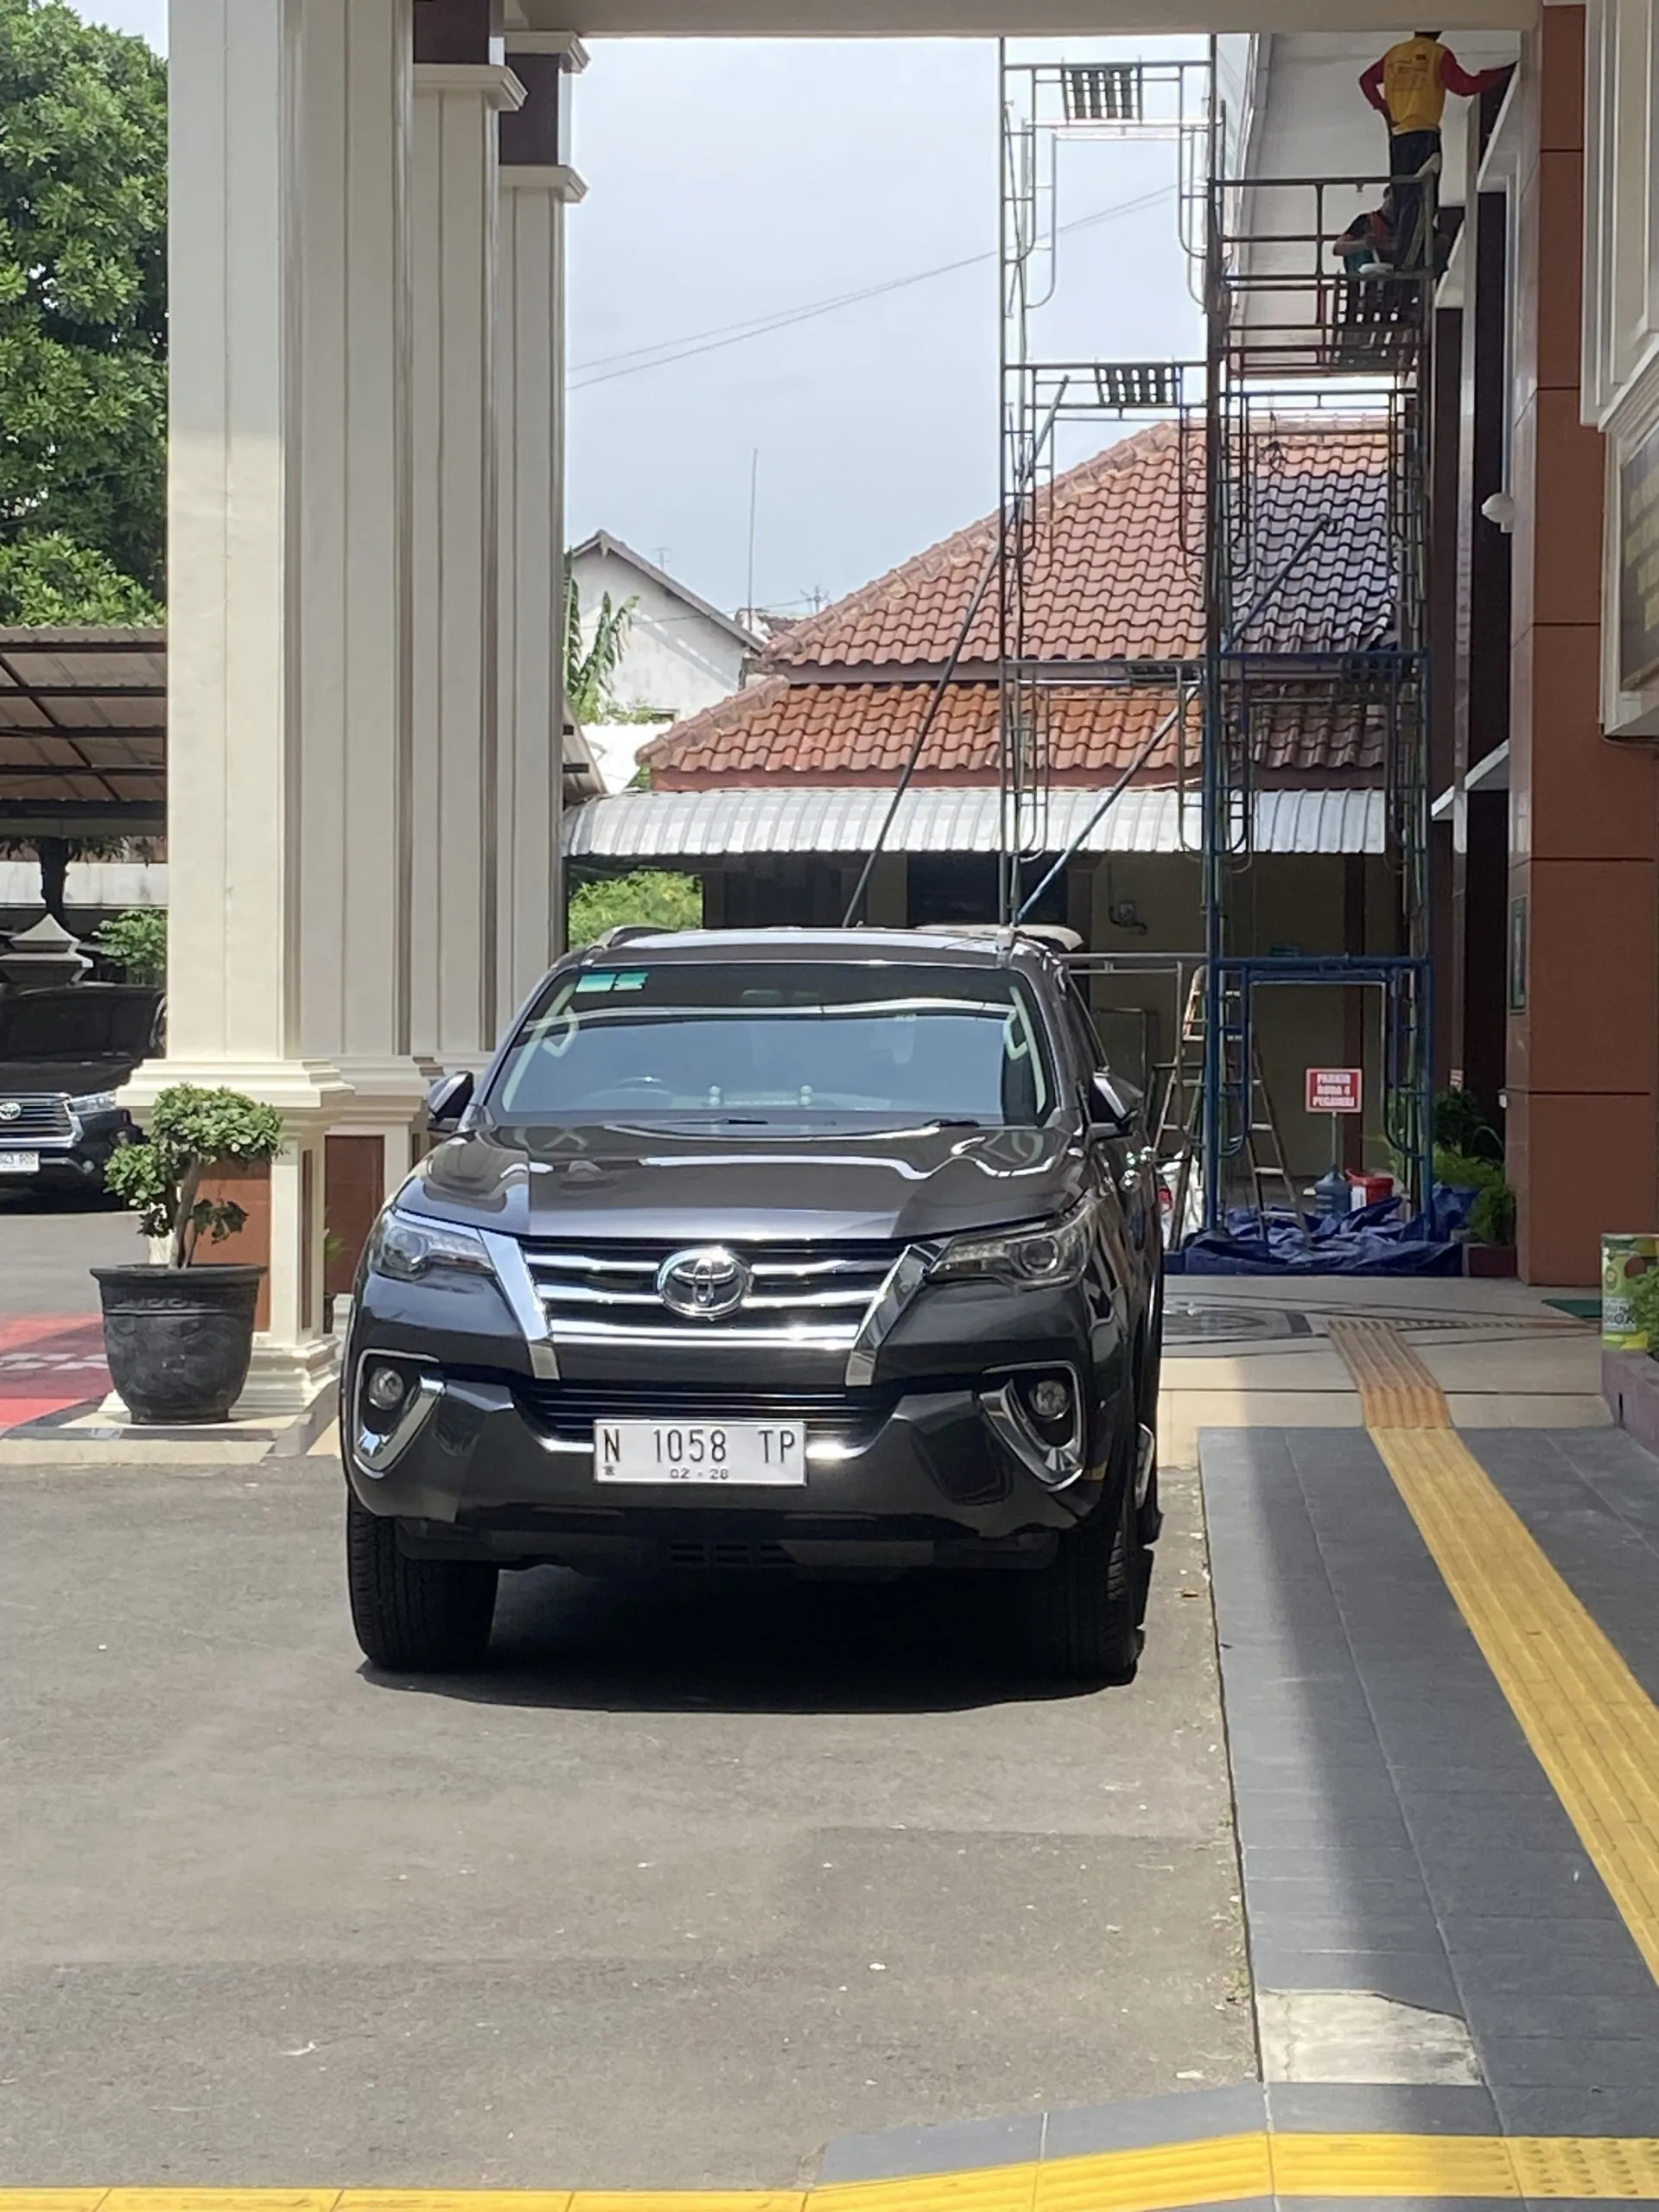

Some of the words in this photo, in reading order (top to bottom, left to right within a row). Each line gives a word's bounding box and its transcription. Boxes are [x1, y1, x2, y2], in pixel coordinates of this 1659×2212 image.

[603, 1427, 621, 1462] N
[653, 1428, 727, 1463] 1058
[758, 1429, 795, 1464] TP
